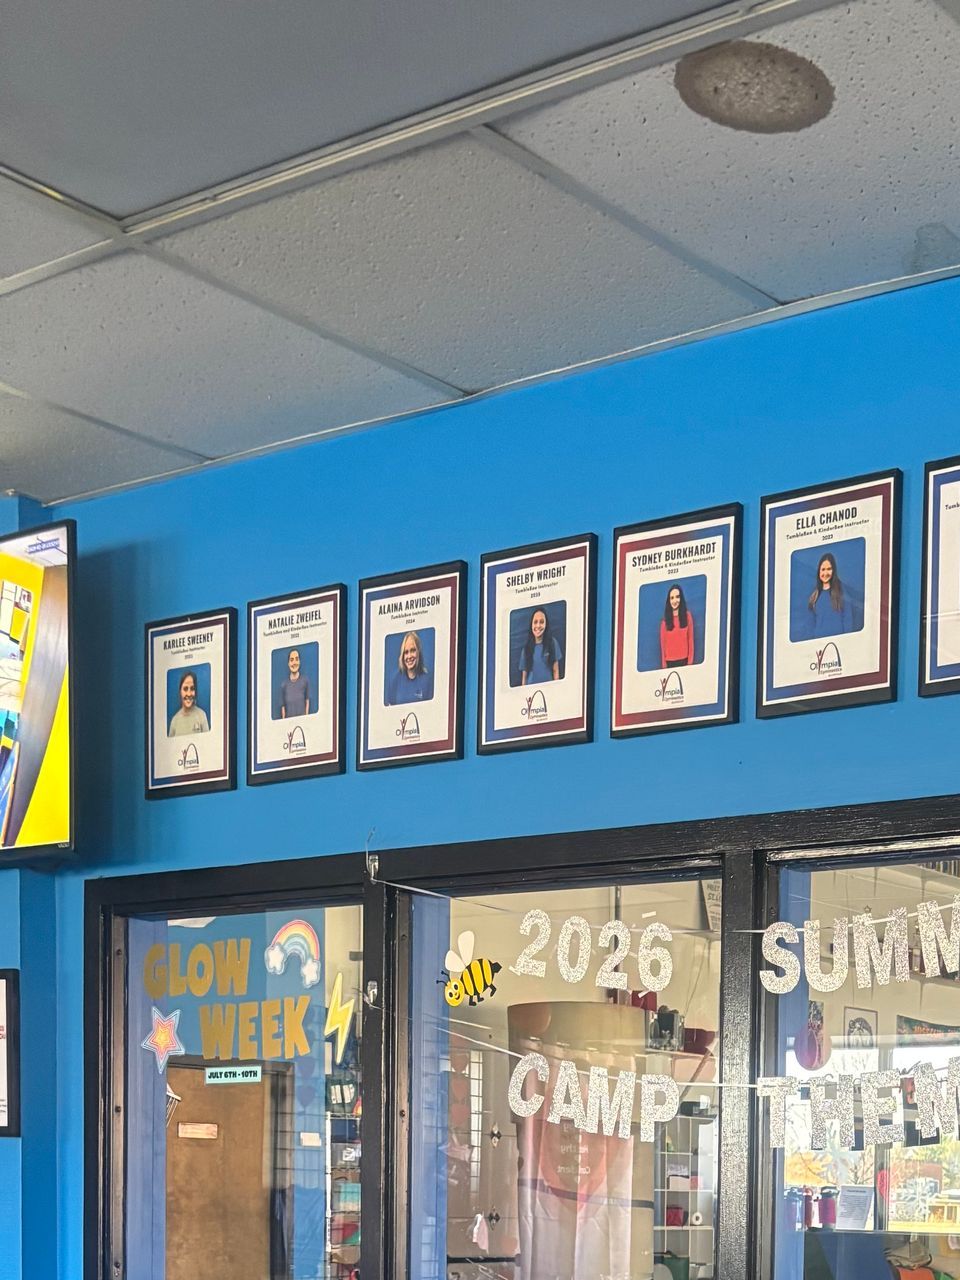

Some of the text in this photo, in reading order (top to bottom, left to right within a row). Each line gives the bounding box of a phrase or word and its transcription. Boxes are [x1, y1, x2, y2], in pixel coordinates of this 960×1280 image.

[796, 507, 858, 530] ELLA CHANOD
[844, 519, 870, 528] Instructor
[632, 542, 716, 567] SYDNEY BURKHARDT
[506, 565, 566, 588] SHELBY WRIGHT
[378, 594, 441, 615] ALAINA ARVIDSON
[268, 609, 322, 630] NATALIE ZWEIFEL
[163, 631, 214, 650] KARLEE SWEENEY
[509, 908, 674, 993] 2026
[143, 938, 252, 999] GLOW
[198, 995, 311, 1061] WEEK
[208, 1071, 223, 1080] JULY
[223, 1070, 238, 1080] 6TH
[241, 1069, 258, 1079] 10TH
[507, 1051, 680, 1143] CAMP
